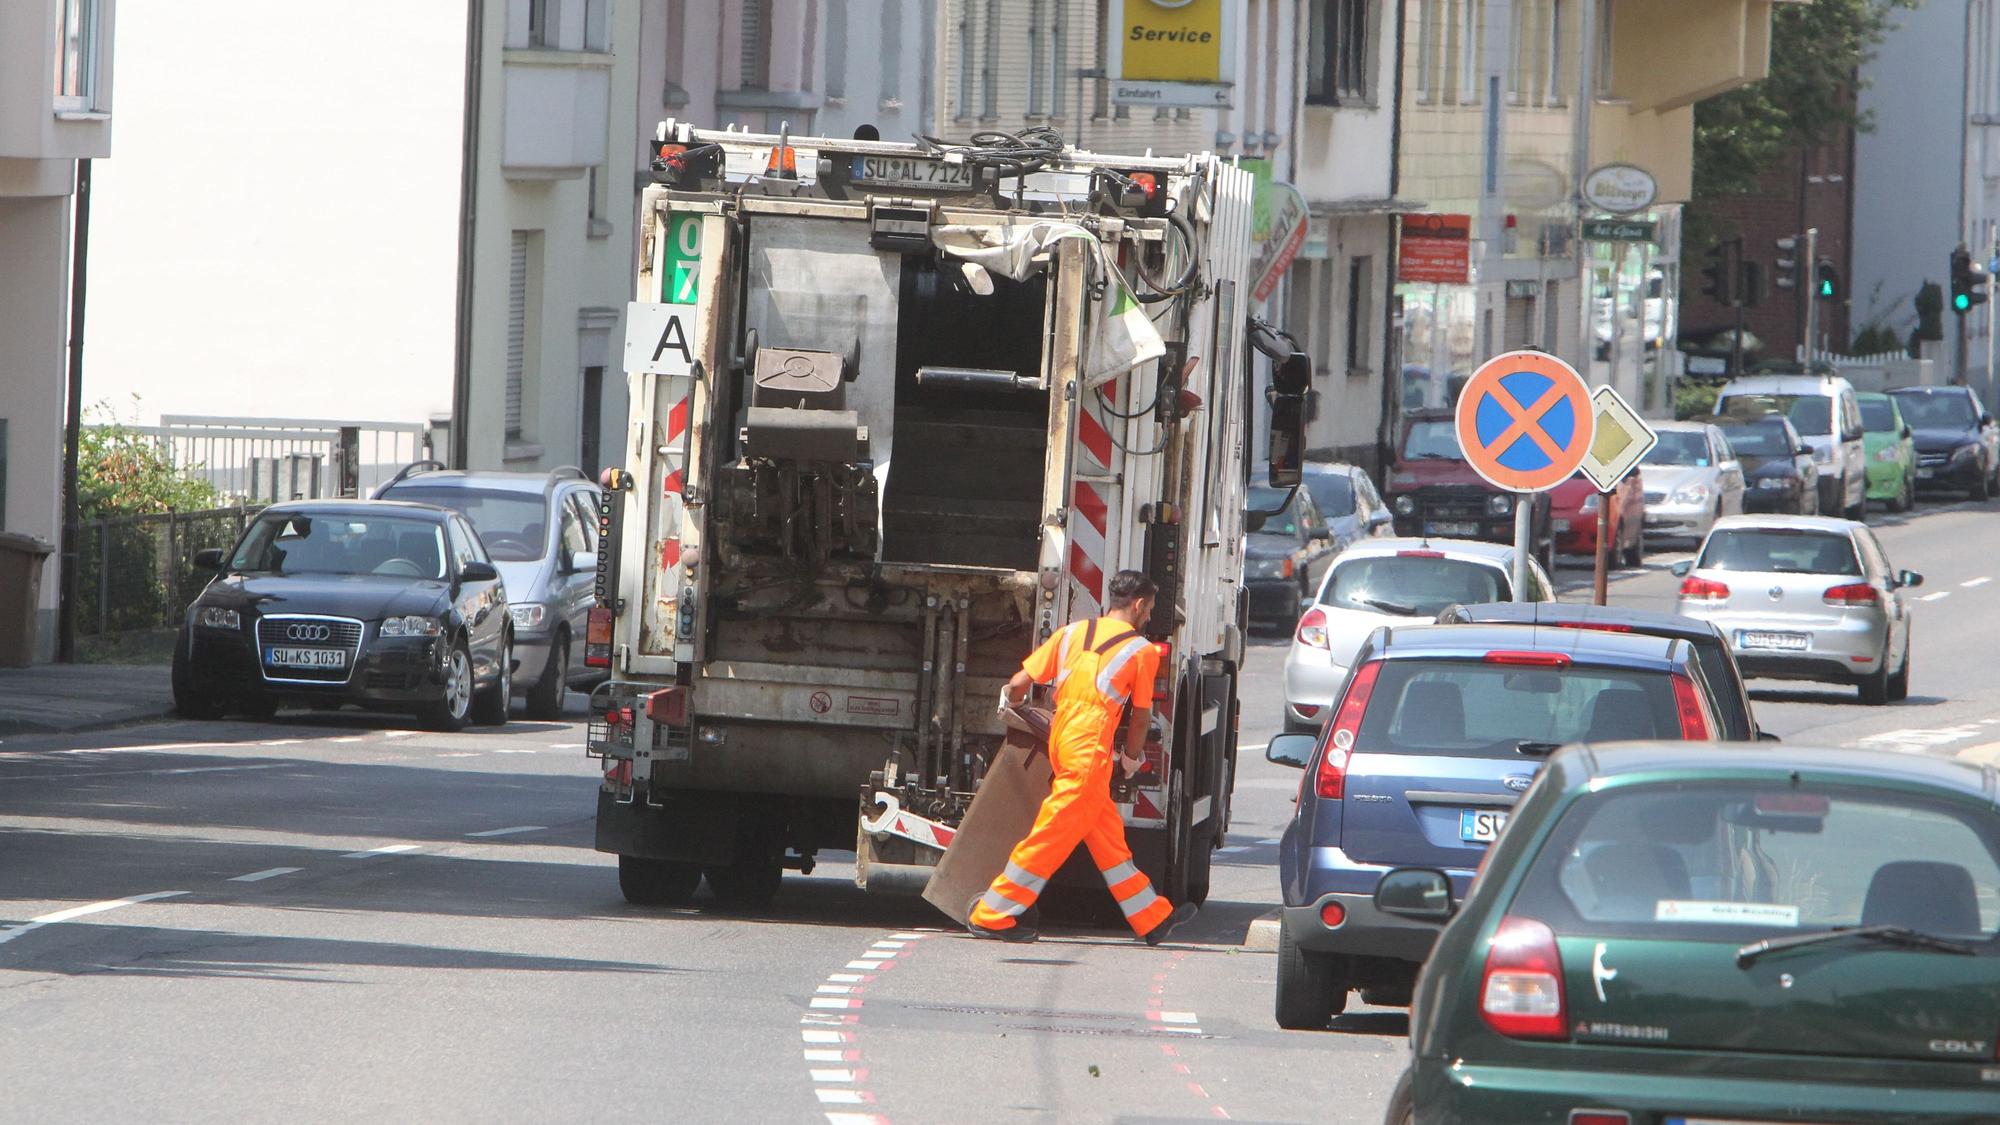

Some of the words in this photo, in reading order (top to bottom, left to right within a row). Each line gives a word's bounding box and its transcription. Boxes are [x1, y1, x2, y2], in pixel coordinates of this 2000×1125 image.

[1130, 25, 1212, 43] Service
[1118, 87, 1162, 99] Einfahrt
[865, 160, 887, 178] SU
[902, 161, 922, 181] AL
[928, 163, 970, 184] 7124
[651, 314, 693, 365] A
[273, 650, 288, 663] SU
[295, 651, 311, 664] KS
[314, 652, 343, 665] 1031
[1591, 1023, 1668, 1040] MITSUBISHI
[1929, 1039, 1986, 1053] COLT
